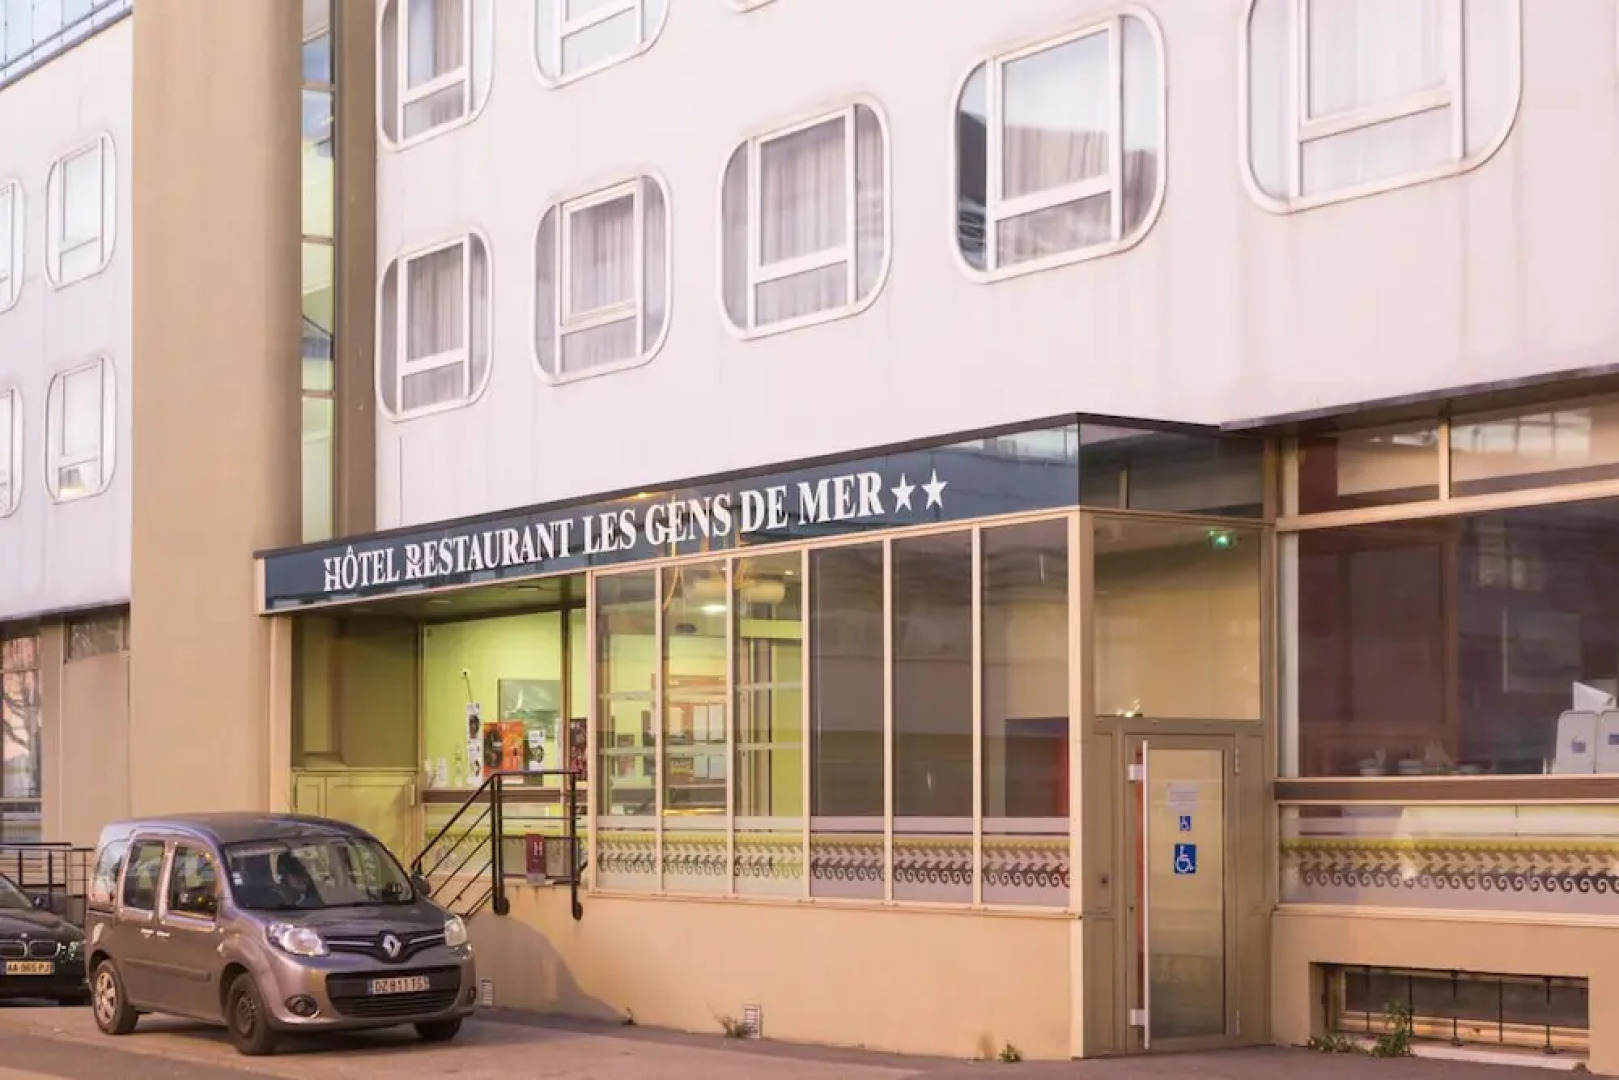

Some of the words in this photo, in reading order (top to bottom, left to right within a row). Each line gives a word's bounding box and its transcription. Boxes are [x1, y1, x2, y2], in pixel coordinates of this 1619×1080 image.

[323, 545, 400, 592] HÔTEL
[405, 519, 573, 579] RESTAURANT
[582, 508, 637, 555] LES
[645, 492, 732, 545] GENS
[740, 485, 789, 533] DE
[797, 471, 885, 525] MER
